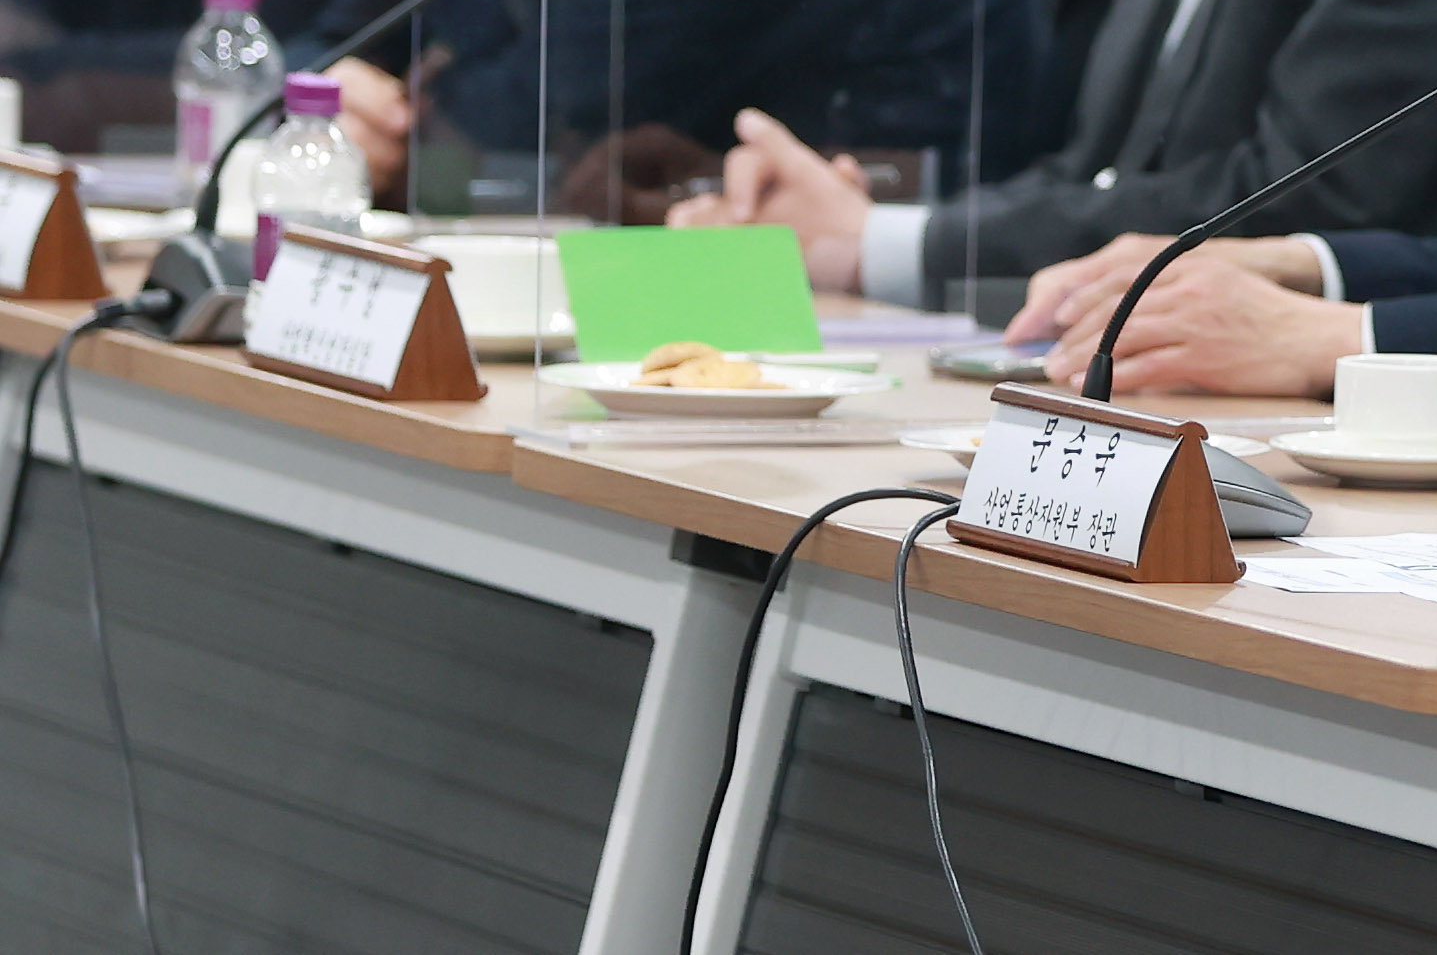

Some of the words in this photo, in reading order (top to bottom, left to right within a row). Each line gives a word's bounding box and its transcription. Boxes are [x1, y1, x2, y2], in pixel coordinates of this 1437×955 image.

[1029, 416, 1121, 487] 문승욱
[983, 485, 1081, 542] 산업통상자원부
[1086, 509, 1117, 552] 장관
